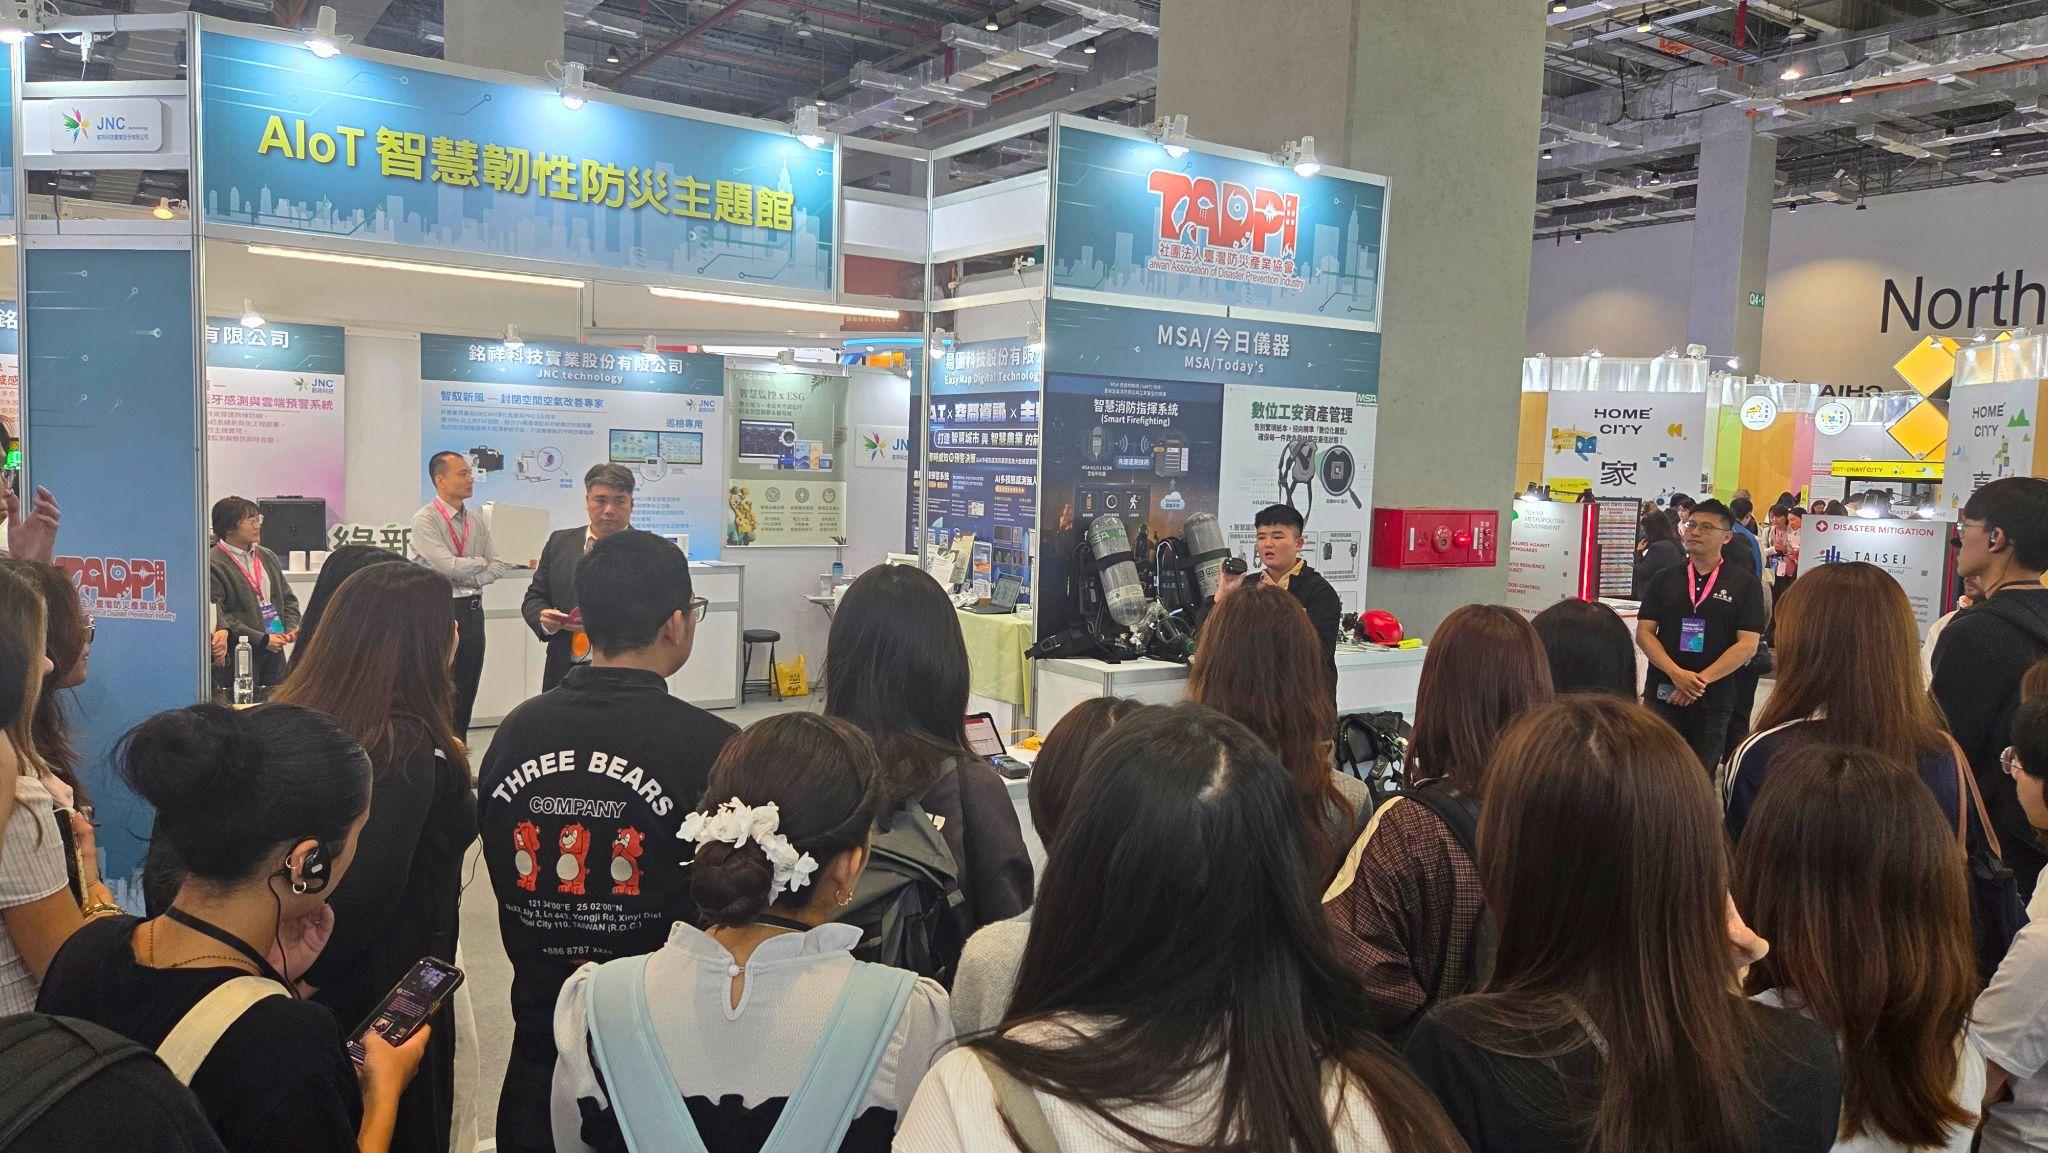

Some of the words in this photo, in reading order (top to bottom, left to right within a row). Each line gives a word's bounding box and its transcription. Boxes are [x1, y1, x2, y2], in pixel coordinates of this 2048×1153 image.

[97, 117, 125, 130] JNC
[257, 115, 365, 168] AIoT
[375, 125, 794, 233] 智慧韌性防災主題館
[1159, 242, 1294, 275] 社團法人臺灣防災產業協會
[1171, 262, 1209, 275] Association
[1209, 266, 1217, 275] of
[1218, 267, 1244, 280] Disaster
[1245, 271, 1279, 285] Prevention
[1881, 269, 2046, 333] North
[1157, 324, 1290, 357] MSA/今日儀器
[468, 344, 684, 374] 銘祥科技實業股份有限公司
[1184, 355, 1264, 376] MSA/Today's
[311, 379, 333, 388] JNC
[537, 370, 559, 379] JNC
[562, 371, 623, 384] technology
[944, 374, 972, 386] EasyMap
[973, 372, 996, 386] Digital
[999, 370, 1040, 383] Technolog
[787, 392, 805, 401] ESG
[1356, 393, 1377, 402] MSA
[699, 400, 715, 408] JNC
[1093, 398, 1179, 416] 智慧消防指揮系統
[1972, 402, 2005, 419] HOME
[955, 402, 1007, 423] 空間資訊
[1020, 400, 1039, 422] 主
[1251, 400, 1353, 424] 數位工安資產管理
[1594, 407, 1653, 420] HOME
[1101, 414, 1125, 424] (Smart
[1126, 415, 1170, 427] Firefighting)
[1599, 424, 1643, 435] CITY
[1974, 424, 1999, 437] CITY
[893, 438, 909, 451] JN
[1600, 460, 1637, 486] 家
[1833, 523, 1876, 533] DISASTER
[1878, 524, 1934, 537] MITIGATION
[1854, 551, 1906, 564] TAISEI
[80, 600, 167, 611] 人臺灣防災產業協會
[107, 610, 127, 618] Disaster
[127, 611, 154, 620] Prevention
[155, 611, 176, 622] Industry
[492, 750, 575, 803] THREE
[588, 751, 673, 817] BEARS
[529, 797, 626, 818] COMPANY
[529, 900, 541, 908] 121
[576, 903, 588, 911] 25
[618, 913, 642, 922] Xinyi
[536, 920, 551, 930] City
[573, 921, 605, 932] TAIWAN
[566, 946, 589, 955] 8787
